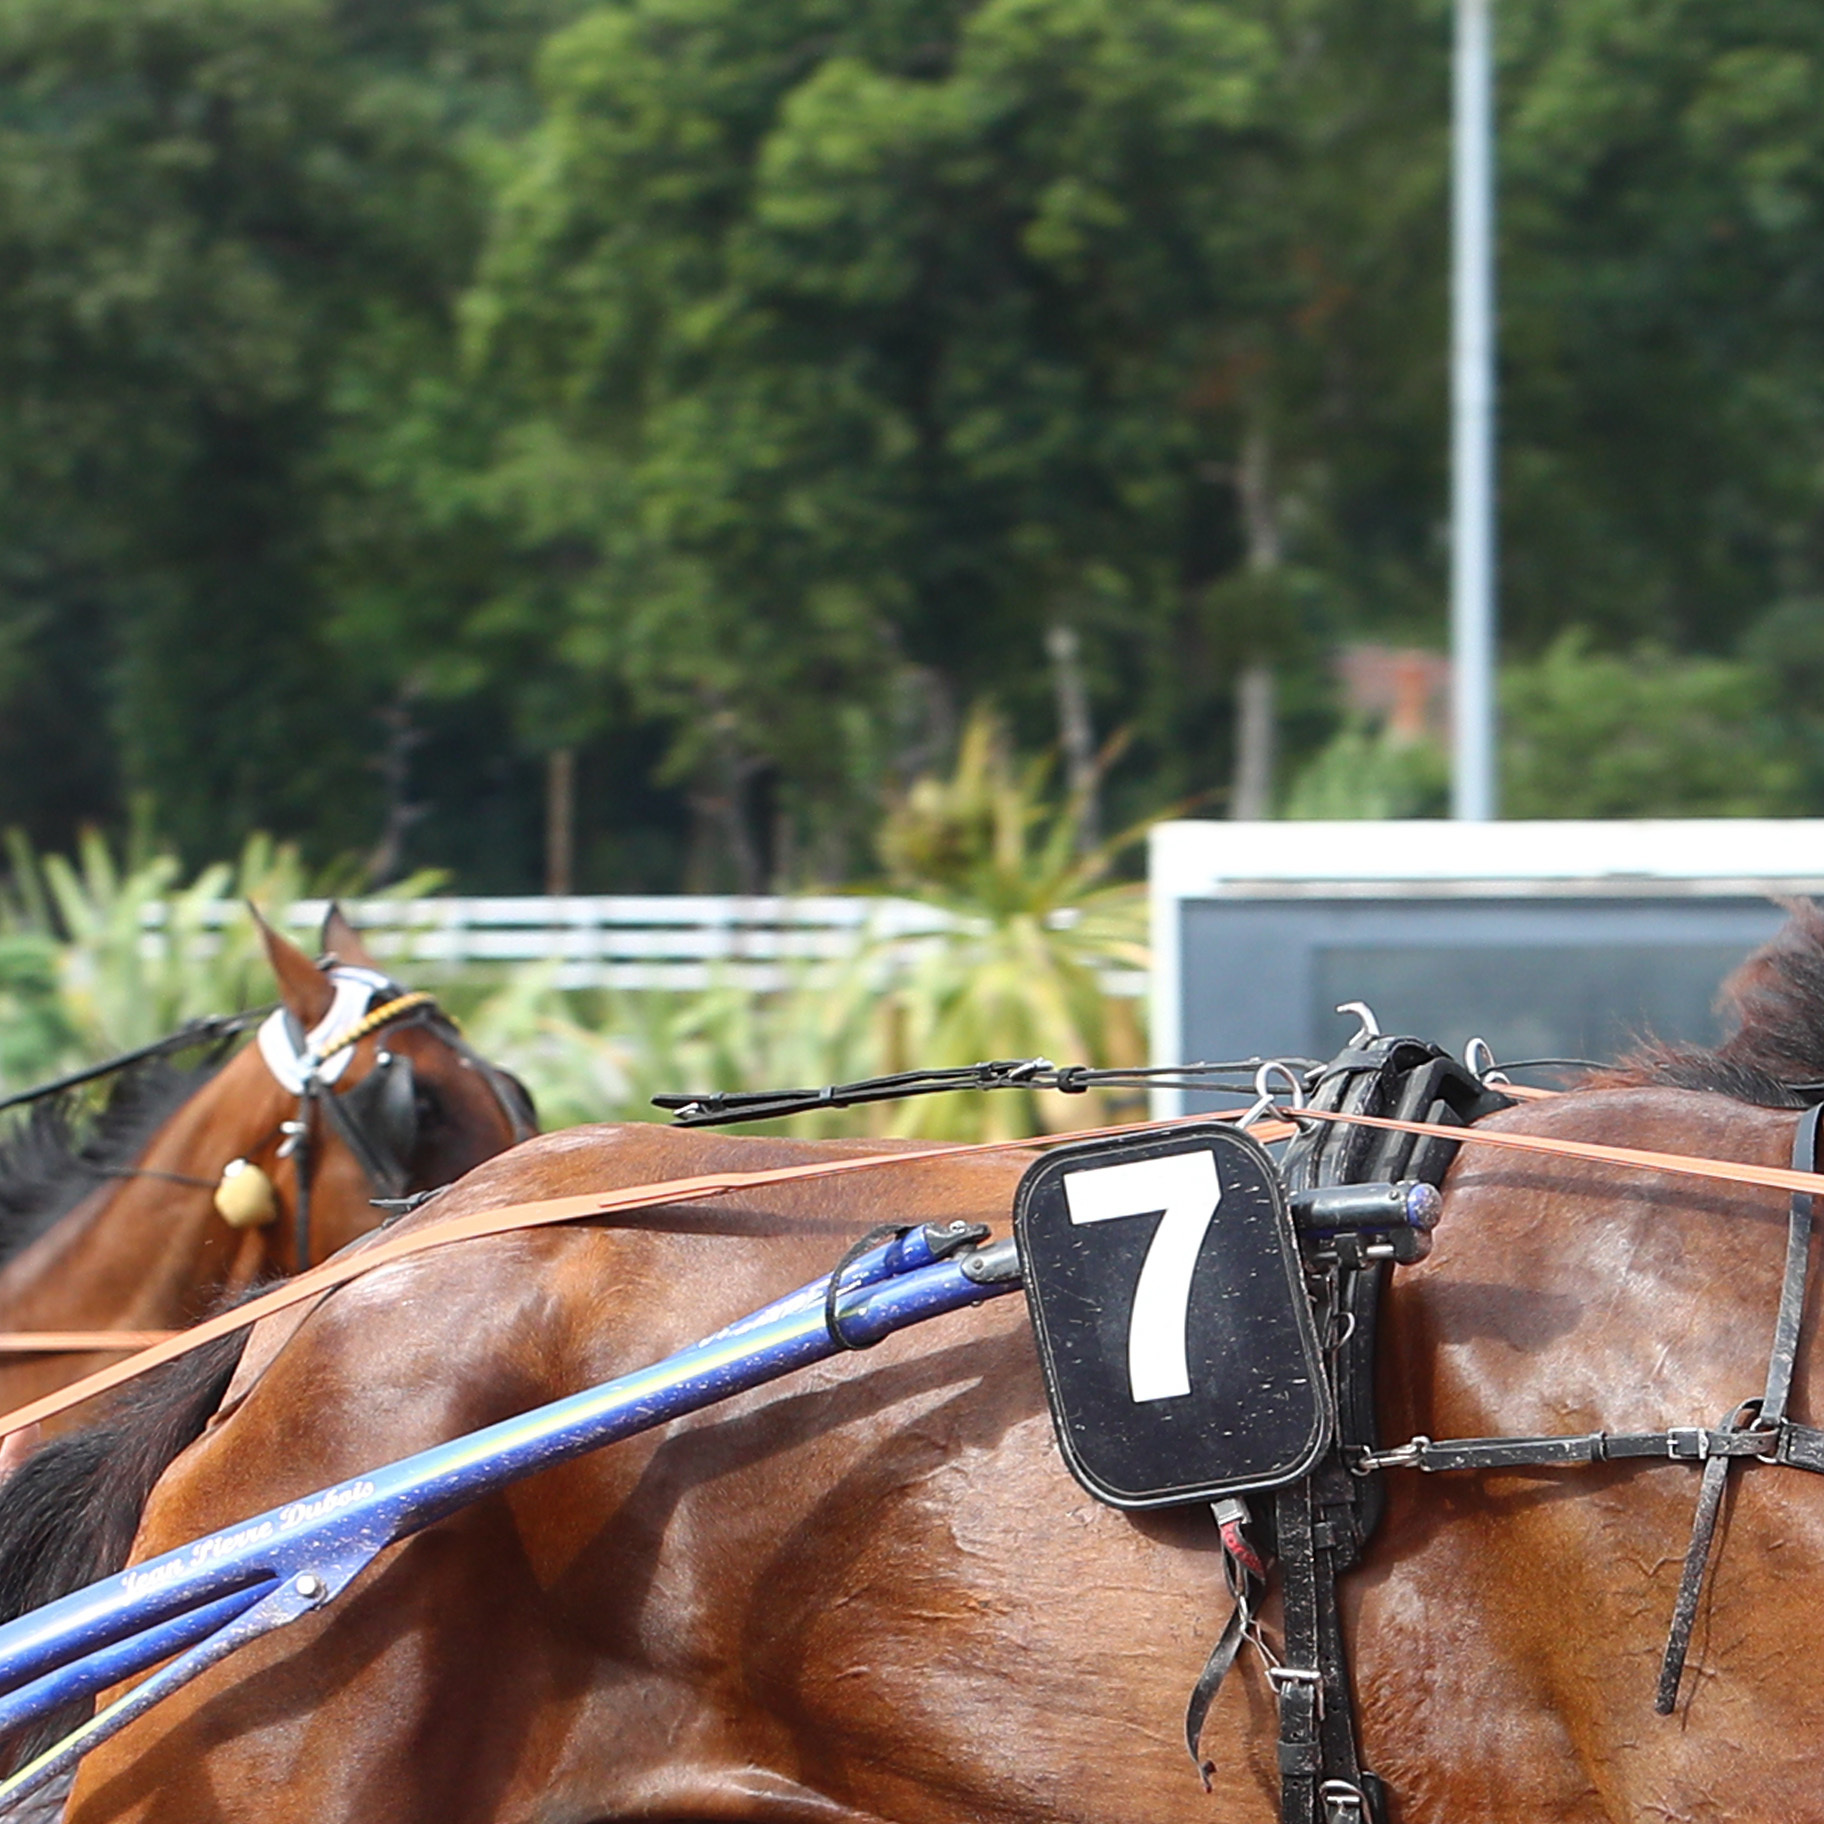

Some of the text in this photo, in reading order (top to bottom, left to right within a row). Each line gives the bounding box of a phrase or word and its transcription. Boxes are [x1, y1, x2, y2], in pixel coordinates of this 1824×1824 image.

[1063, 1149, 1222, 1403] 7
[121, 1481, 375, 1597] Jean Pierre Dubois
